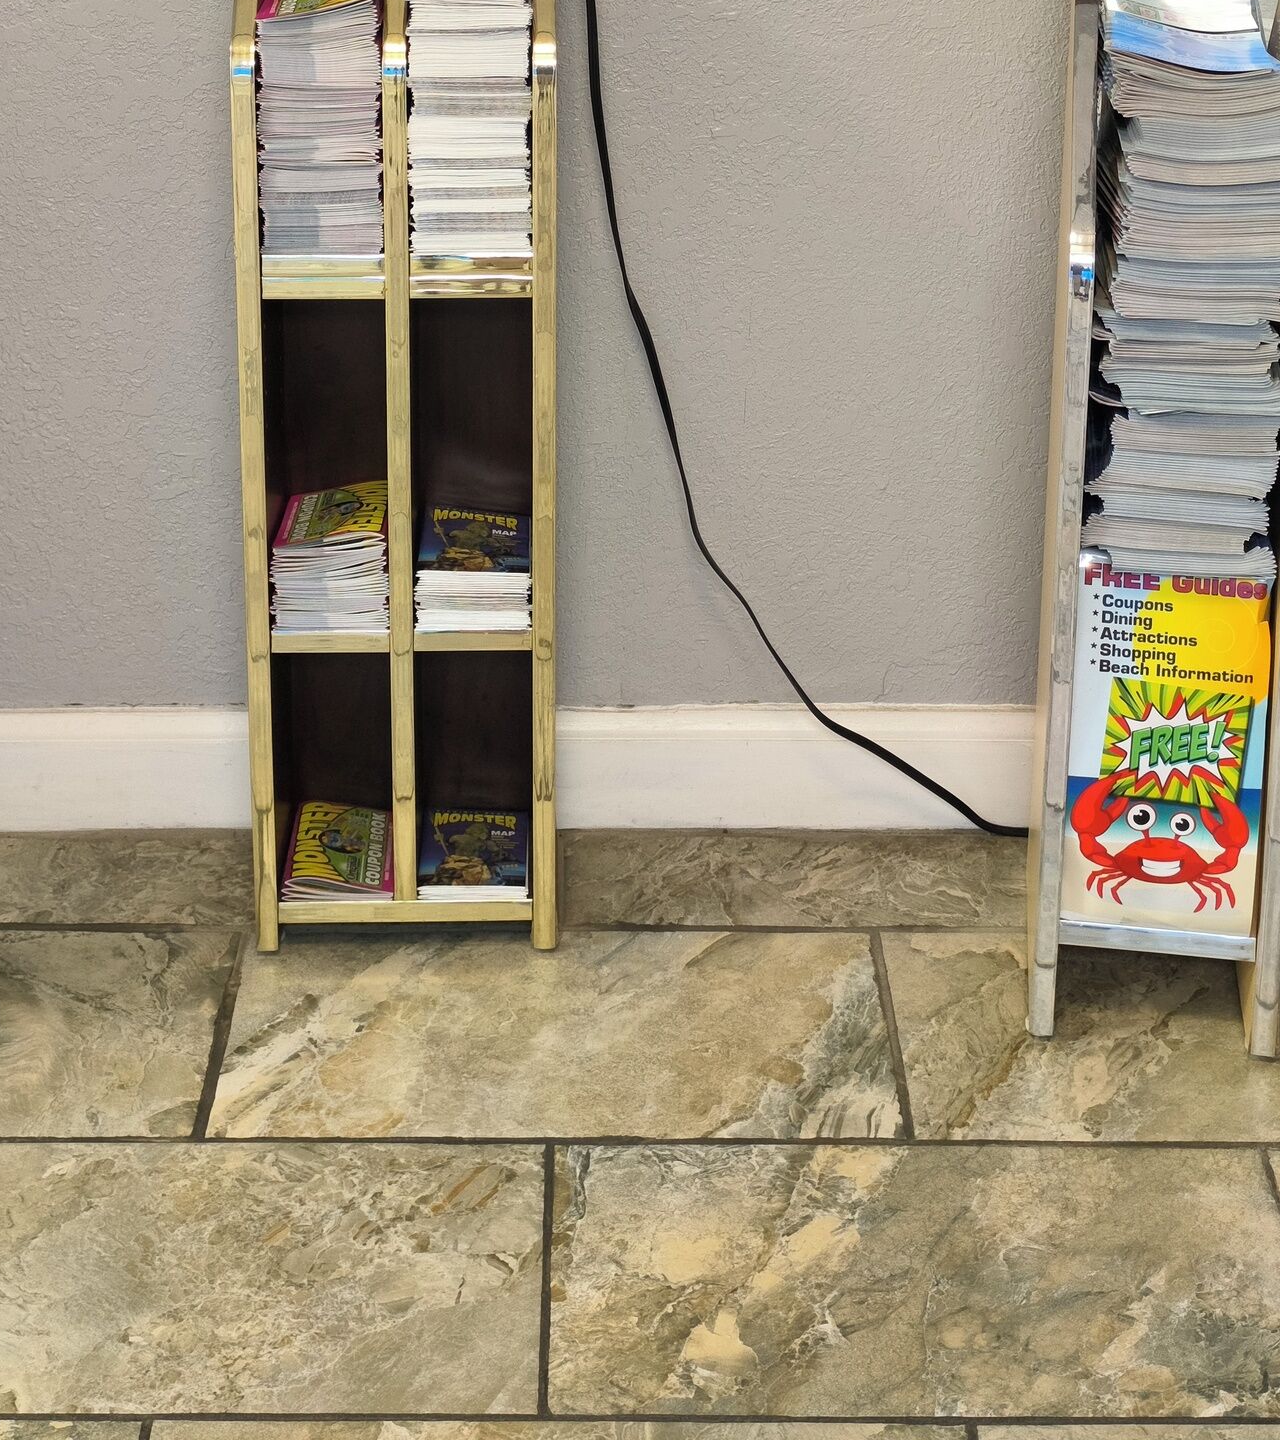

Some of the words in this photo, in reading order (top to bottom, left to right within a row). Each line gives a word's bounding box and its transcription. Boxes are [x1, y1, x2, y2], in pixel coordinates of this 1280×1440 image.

[434, 508, 518, 530] MONSTER
[1084, 562, 1161, 591] FREE
[1172, 574, 1268, 601] Guides
[1102, 593, 1174, 613] Coupons
[1101, 610, 1153, 630] Dining
[1100, 627, 1198, 647] Attractions
[1099, 643, 1176, 665] Shopping
[1099, 659, 1149, 676] Beach
[1156, 664, 1254, 684] Information
[1129, 720, 1227, 772] FREE!
[370, 812, 387, 841] BOOK
[432, 812, 517, 830] MONSTER
[292, 802, 354, 882] MONSTER
[365, 842, 383, 885] COUPON
